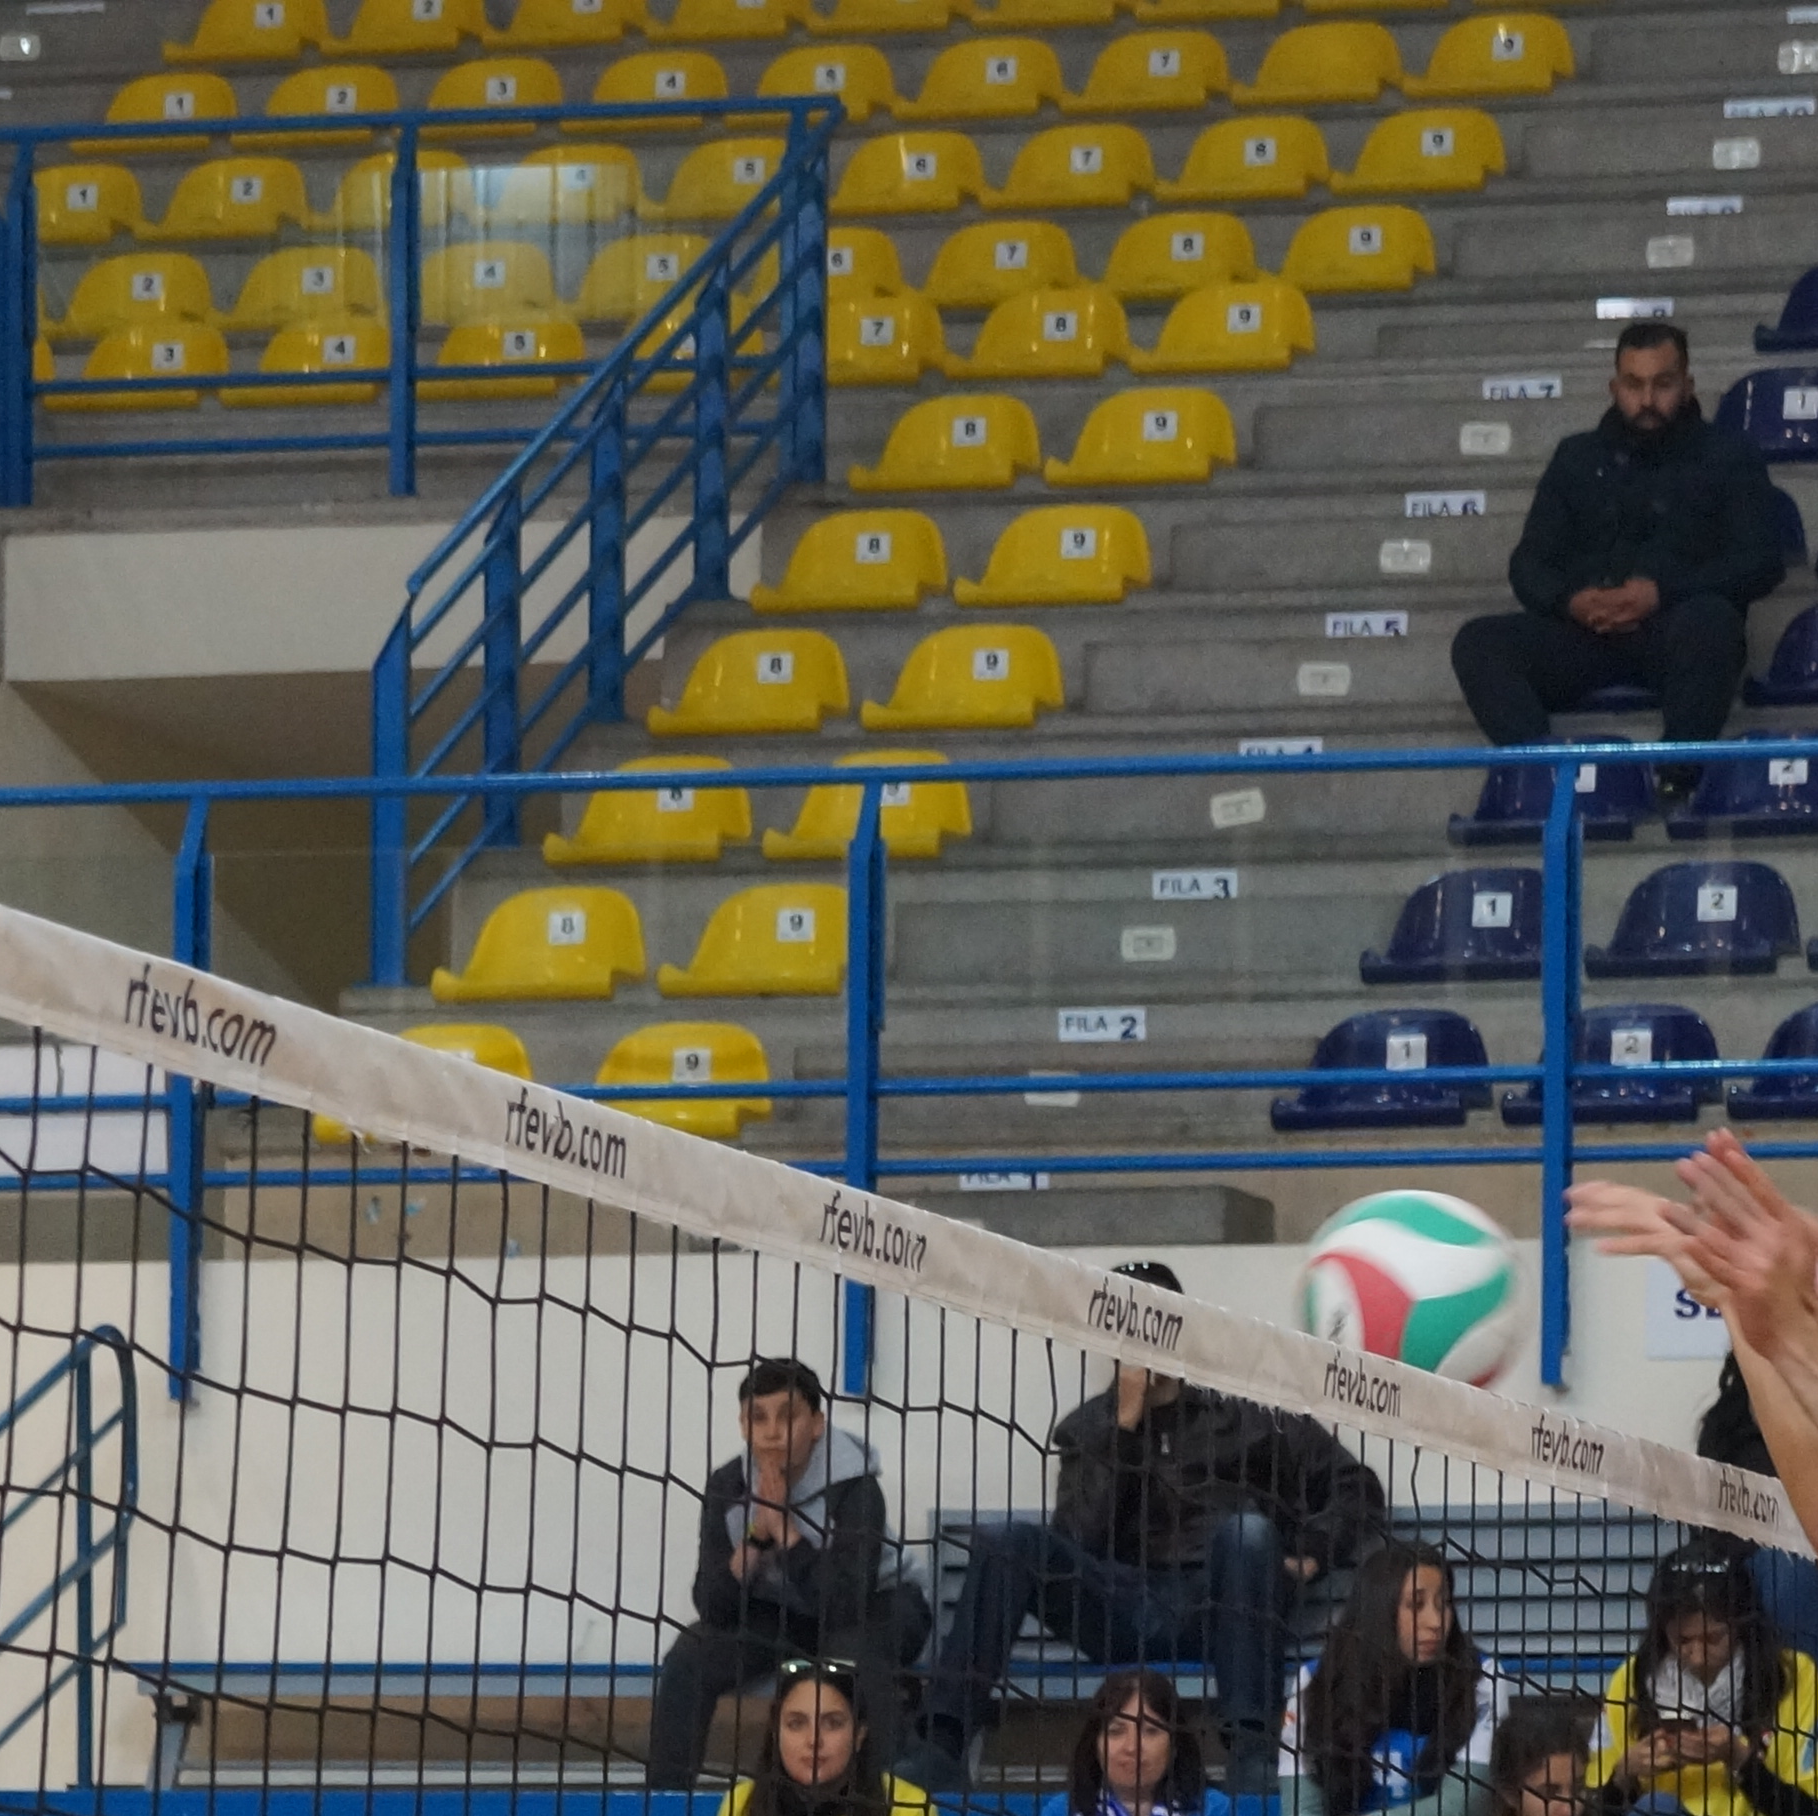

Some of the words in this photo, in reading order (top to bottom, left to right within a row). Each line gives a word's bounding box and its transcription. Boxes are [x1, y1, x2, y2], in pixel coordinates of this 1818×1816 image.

[1331, 619, 1372, 637] FILA
[1159, 878, 1202, 895] FILA
[1213, 877, 1231, 899] 3
[125, 962, 277, 1067] rfevb.com
[1065, 1015, 1109, 1033] FILA
[1119, 1015, 1138, 1041] 2
[504, 1088, 627, 1180] rfevb.com
[819, 1190, 928, 1273] rfevb.com
[1087, 1277, 1184, 1351] rfevb.com
[1323, 1350, 1401, 1418] rfevb.com
[1530, 1414, 1605, 1475] rfevb.com
